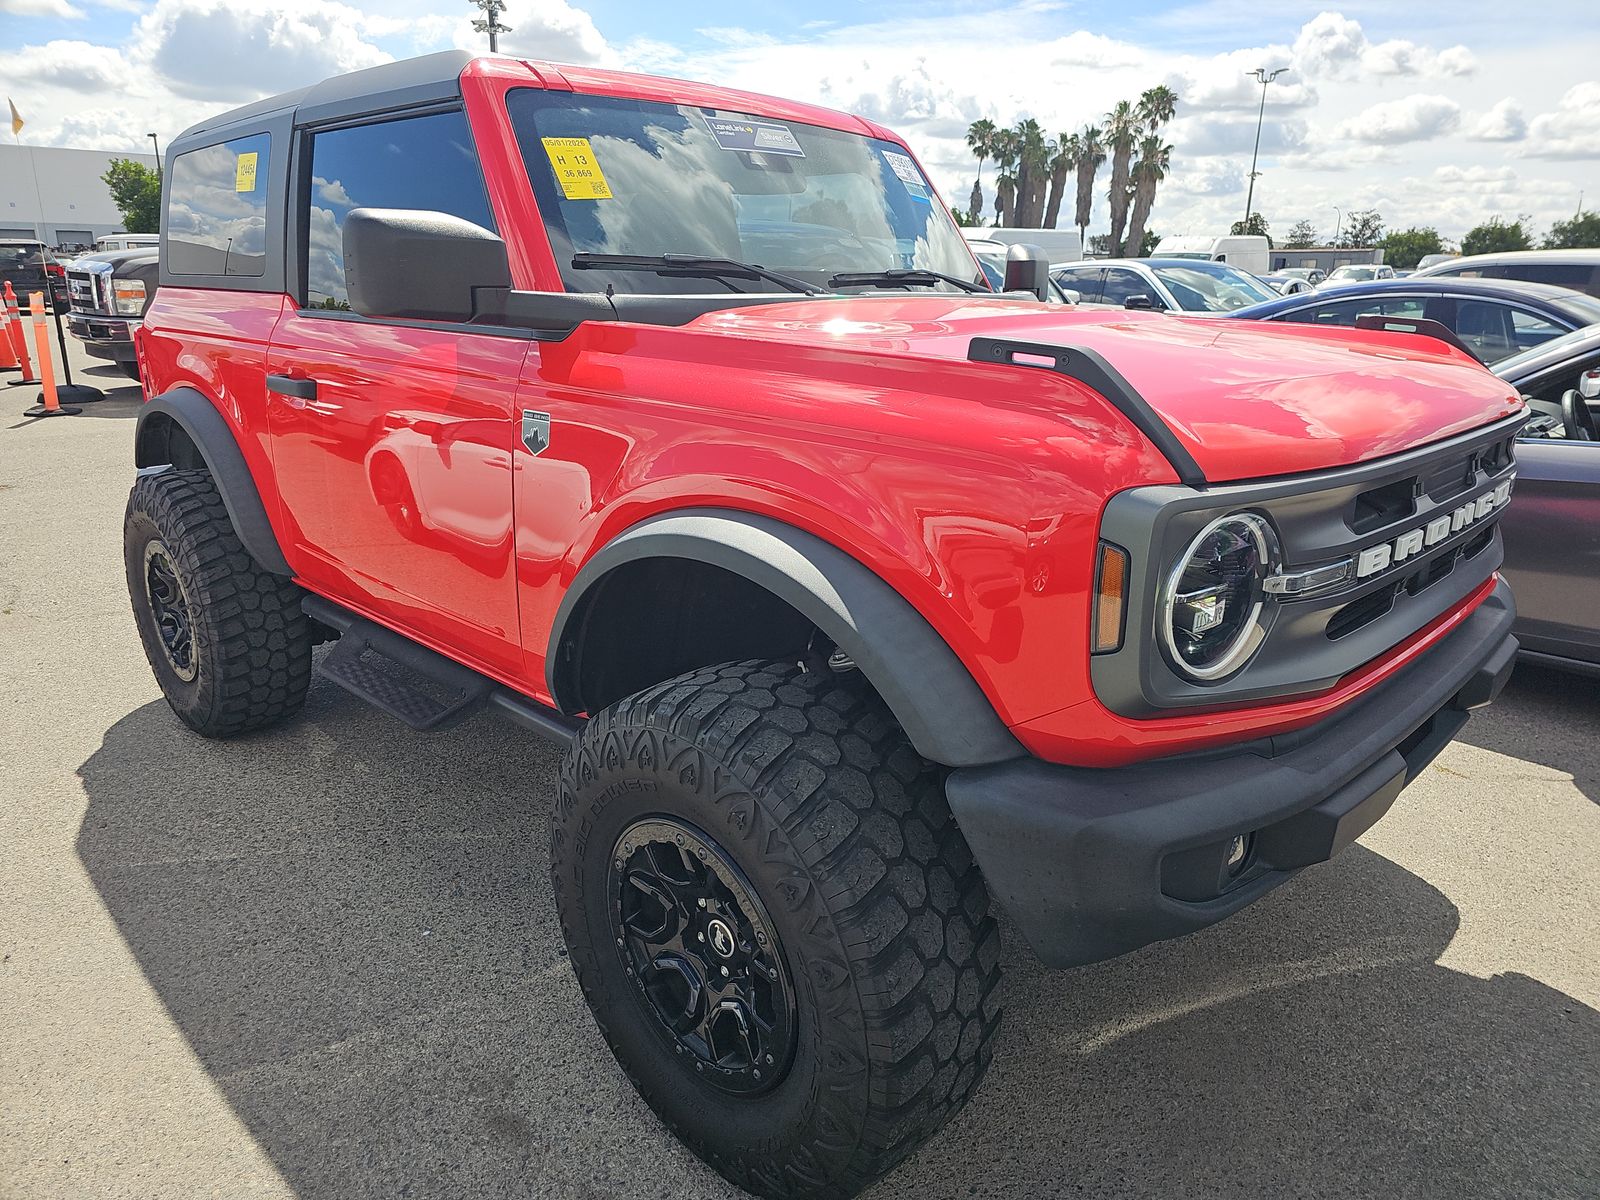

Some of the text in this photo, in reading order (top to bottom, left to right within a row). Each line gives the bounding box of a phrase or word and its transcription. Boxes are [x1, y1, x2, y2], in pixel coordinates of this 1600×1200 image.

[711, 122, 745, 133] LaneLink
[760, 132, 783, 142] Silver
[544, 139, 586, 147] 05/01/2026
[556, 155, 588, 165] H 13
[563, 169, 593, 178] 36,869
[1356, 480, 1511, 578] BRONCO
